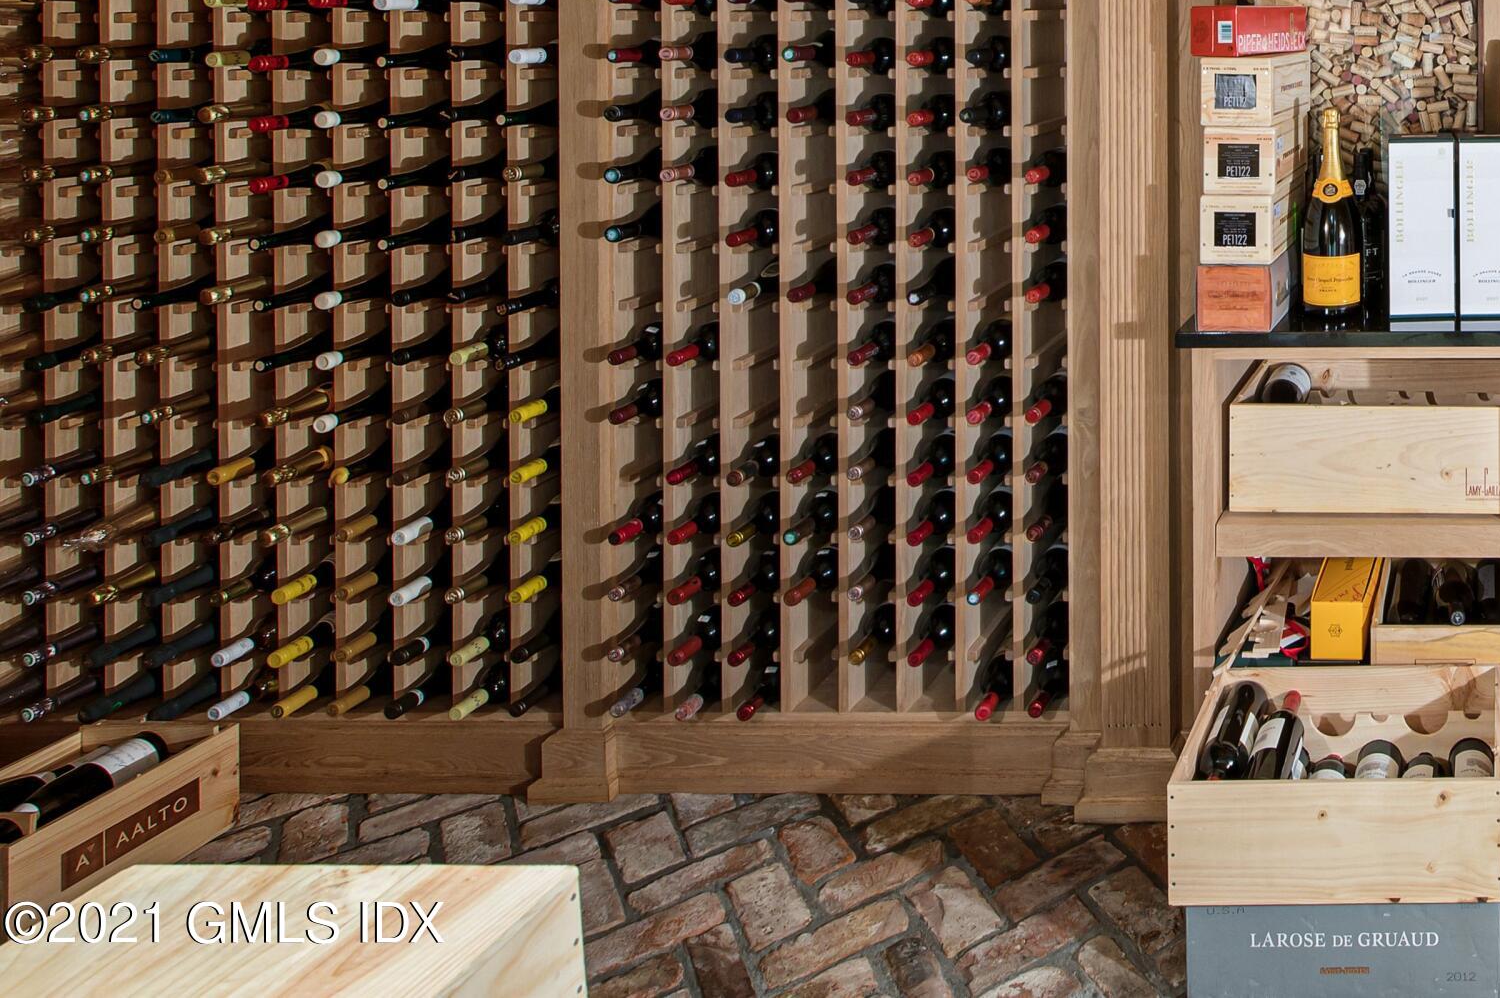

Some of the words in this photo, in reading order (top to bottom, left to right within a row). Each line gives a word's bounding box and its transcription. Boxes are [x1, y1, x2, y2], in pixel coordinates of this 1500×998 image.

[1226, 165, 1251, 177] PE1122
[1222, 234, 1248, 245] PE1122
[115, 796, 188, 849] AALTO
[1250, 932, 1326, 948] LAROSE
[1332, 934, 1354, 948] DE
[1357, 931, 1440, 948] GRUAUD
[1445, 971, 1478, 983] 2012
